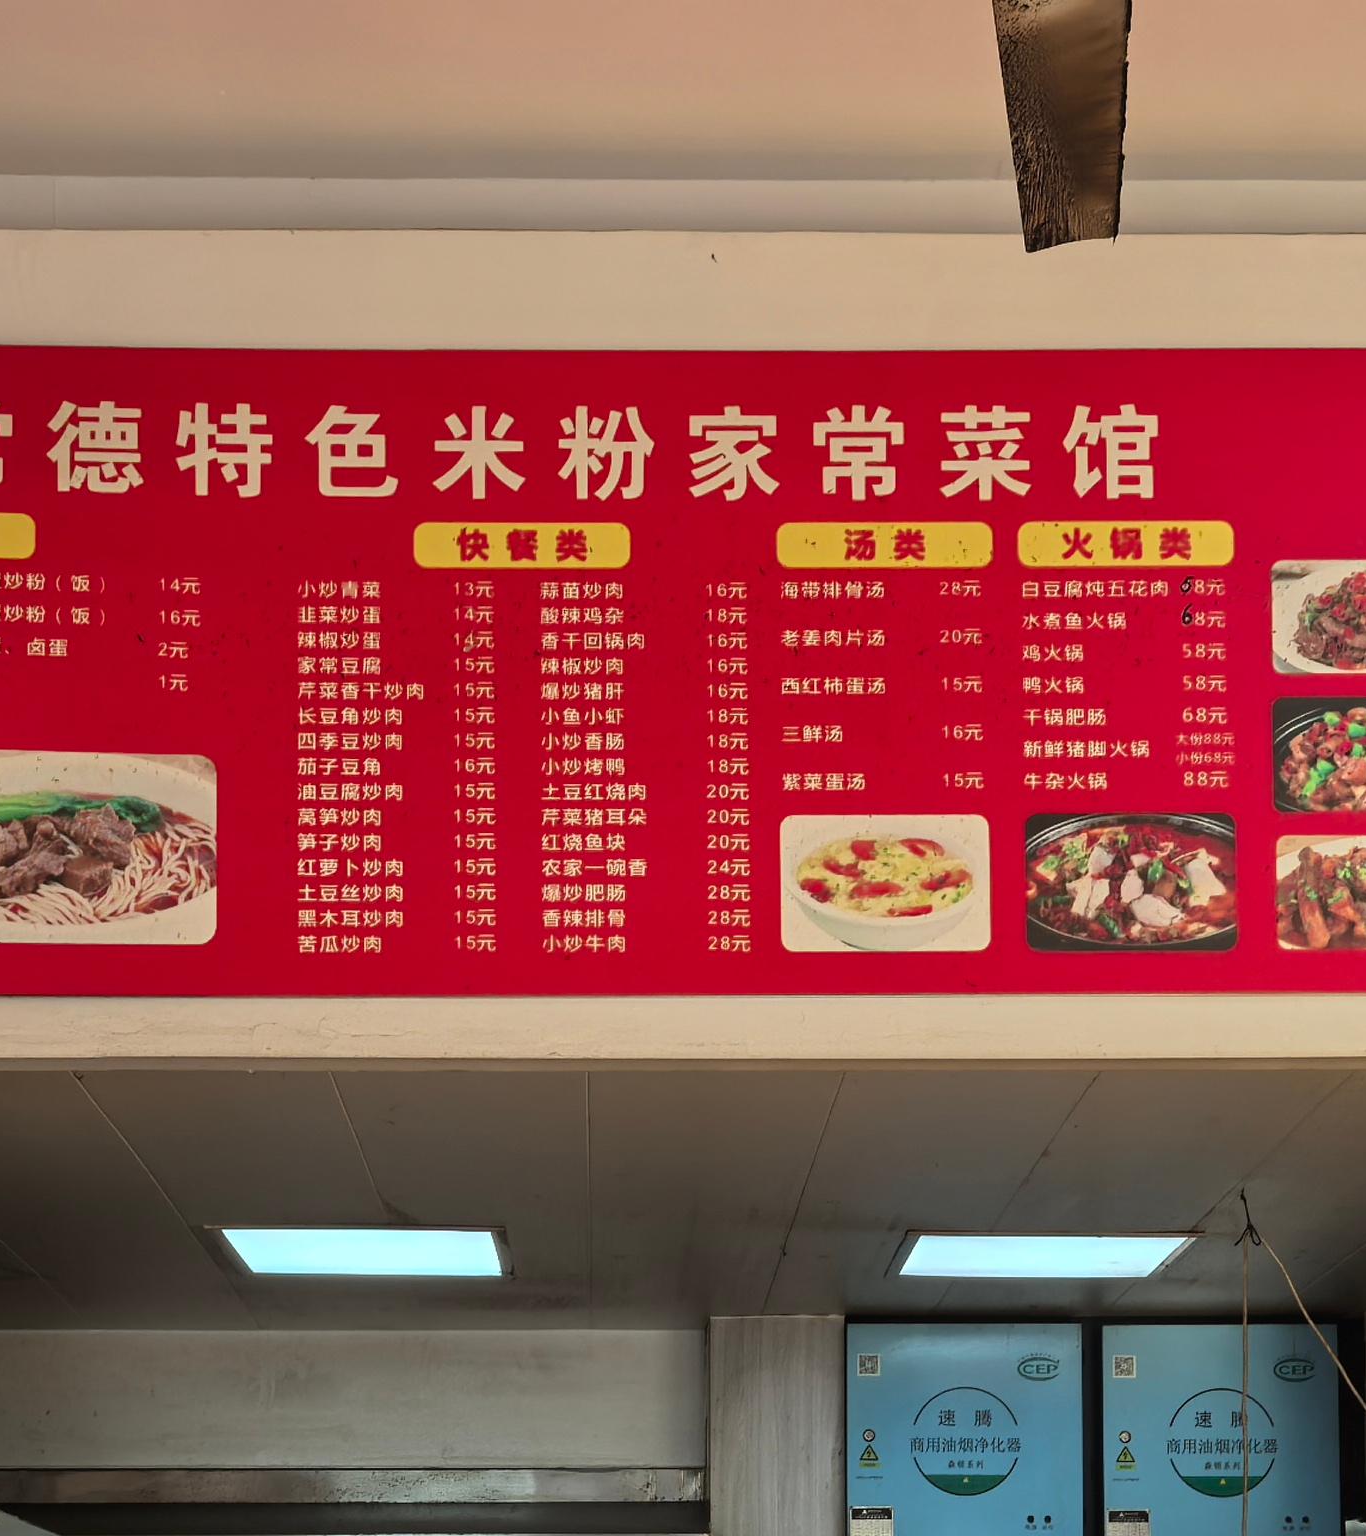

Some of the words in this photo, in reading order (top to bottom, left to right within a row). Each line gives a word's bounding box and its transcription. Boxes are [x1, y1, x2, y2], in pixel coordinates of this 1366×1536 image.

[456, 528, 588, 563] 快餐类
[844, 529, 927, 561] 汤类
[1062, 528, 1193, 560] 火锅类
[160, 577, 201, 595] 14元
[297, 580, 381, 599] 小炒青菜
[454, 580, 494, 599] 13元
[540, 581, 624, 600] 蒜苗炒肉
[708, 581, 748, 600] 16元
[780, 580, 885, 600] 海带排骨汤
[939, 579, 982, 597] 28元
[1022, 579, 1169, 598] 白豆腐炖五花肉
[159, 609, 201, 628] 16元
[298, 605, 381, 624] 韭菜炒蛋
[454, 605, 495, 625] 14元
[540, 606, 624, 625] 酸辣鸡杂
[707, 606, 748, 625] 18元
[1022, 611, 1127, 630] 水煮鱼火锅
[297, 630, 381, 650] 辣椒炒蛋
[540, 631, 645, 651] 香干回锅肉
[708, 631, 748, 650] 16元
[781, 629, 885, 647] 老姜肉片汤
[939, 628, 983, 645] 20元
[157, 641, 189, 659] 2元
[1022, 643, 1084, 662] 鸡火锅
[1182, 642, 1227, 661] 58元
[297, 655, 381, 675] 家常豆腐
[454, 656, 495, 674] 15元
[540, 656, 624, 676] 辣椒炒肉
[707, 657, 748, 676] 16元
[159, 673, 189, 692] 1元
[297, 681, 424, 701] 芹菜香干炒肉
[453, 681, 495, 700] 15元
[540, 681, 625, 701] 爆炒猪肝
[707, 682, 749, 700] 16元
[781, 676, 886, 695] 西红柿蛋汤
[941, 675, 983, 694] 15元
[1022, 676, 1084, 695] 鸭火锅
[1182, 674, 1227, 693] 58元
[298, 706, 403, 726] 长豆角炒肉
[454, 706, 496, 725] 15元
[540, 707, 624, 726] 小鱼小虾
[707, 707, 749, 726] 18元
[1023, 708, 1107, 726] 干锅肥肠
[1182, 706, 1228, 725] 68元
[297, 732, 403, 751] 四季豆炒肉
[454, 731, 496, 750] 15元
[541, 732, 625, 751] 小炒香肠
[707, 732, 749, 751] 18元
[781, 724, 843, 743] 三鲜汤
[943, 723, 984, 741] 16元
[1023, 739, 1150, 758] 新鲜猪脚火锅
[297, 757, 381, 776] 茄子豆角
[454, 757, 496, 775] 16元
[541, 757, 626, 776] 小炒烤鸭
[707, 757, 750, 776] 18元
[782, 772, 866, 791] 紫菜蛋汤
[943, 771, 985, 789] 15元
[1023, 772, 1108, 790] 牛杂火锅
[1183, 770, 1229, 788] 88元
[297, 782, 403, 801] 油豆腐炒肉
[454, 782, 496, 800] 15元
[541, 782, 647, 801] 土豆红烧肉
[706, 782, 750, 801] 20元
[453, 807, 497, 825] 15元
[541, 807, 647, 827] 芹菜猪耳朵
[707, 808, 750, 826] 20元
[297, 832, 382, 852] 笋子炒肉
[454, 832, 497, 851] 15元
[541, 832, 626, 852] 红烧鱼块
[706, 833, 750, 851] 20元
[297, 858, 404, 878] 红萝卜炒肉
[454, 857, 497, 876] 15元
[541, 858, 648, 877] 农家一碗香
[707, 858, 751, 877] 24元
[297, 883, 404, 903] 土豆丝炒肉
[454, 882, 497, 901] 15元
[541, 883, 626, 903] 爆炒肥肠
[707, 883, 751, 902] 28元
[297, 908, 404, 928] 黑木耳炒肉
[454, 908, 497, 927] 15元
[542, 908, 626, 928] 香辣排骨
[707, 908, 751, 928] 28元
[297, 934, 382, 954] 苦瓜炒肉
[455, 933, 497, 952] 15元
[542, 934, 626, 953] 小炒牛肉
[708, 934, 751, 953] 28元
[1021, 1365, 1057, 1375] CEP
[1277, 1366, 1314, 1375] CEP
[938, 1410, 992, 1427] 速腾
[910, 1436, 1021, 1453] 商用油烟净化器
